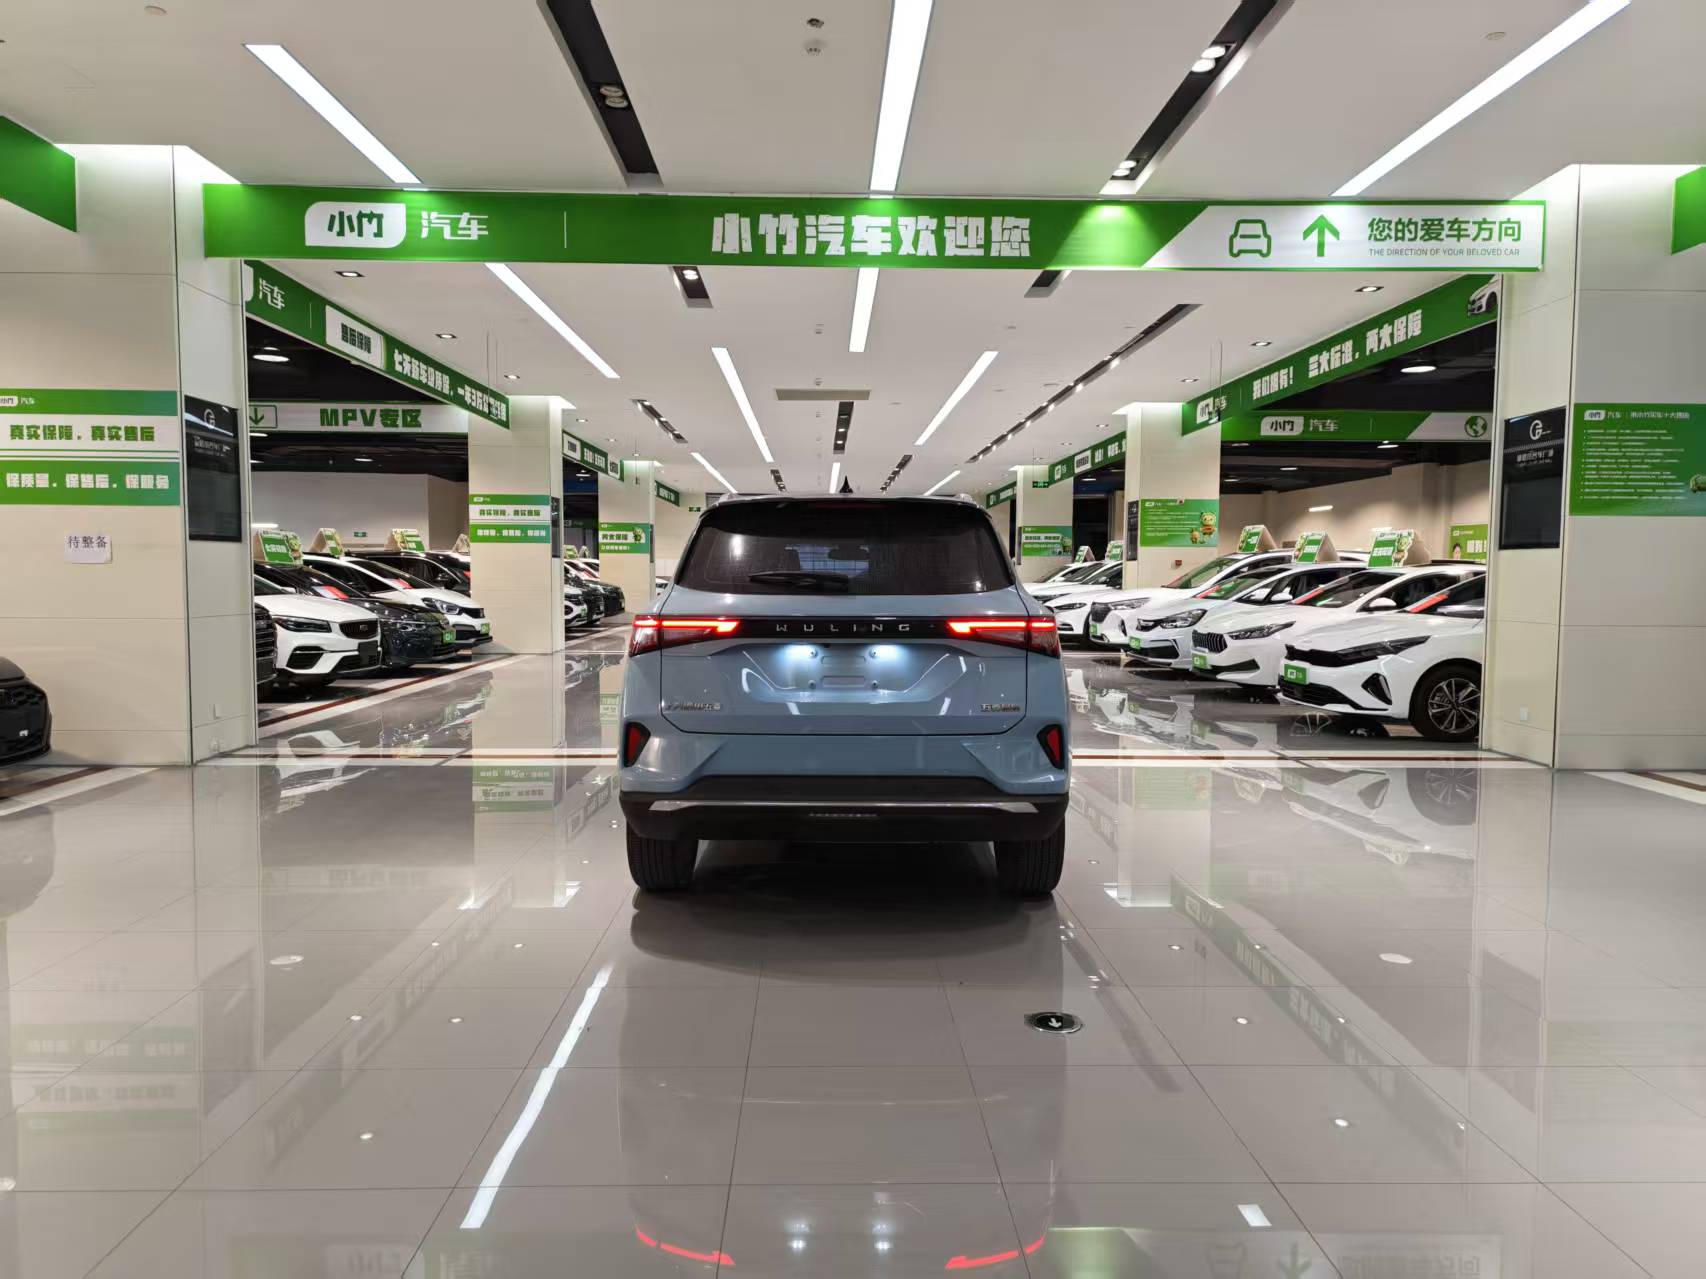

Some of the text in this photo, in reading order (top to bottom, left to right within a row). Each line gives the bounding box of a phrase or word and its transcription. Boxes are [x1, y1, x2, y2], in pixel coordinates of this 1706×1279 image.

[327, 209, 489, 240] 小竹 汽车
[711, 212, 1031, 257] 小竹汽车欢迎您
[1367, 216, 1522, 242] 您的爱车方向
[1369, 248, 1520, 256] THE DIRECTION OF YOUR BELOVED CAR
[258, 277, 285, 311] 汽车
[319, 408, 422, 428] MPV专区
[1309, 419, 1339, 432] 汽车
[67, 535, 108, 549] 待整备
[775, 623, 910, 632] WULING
